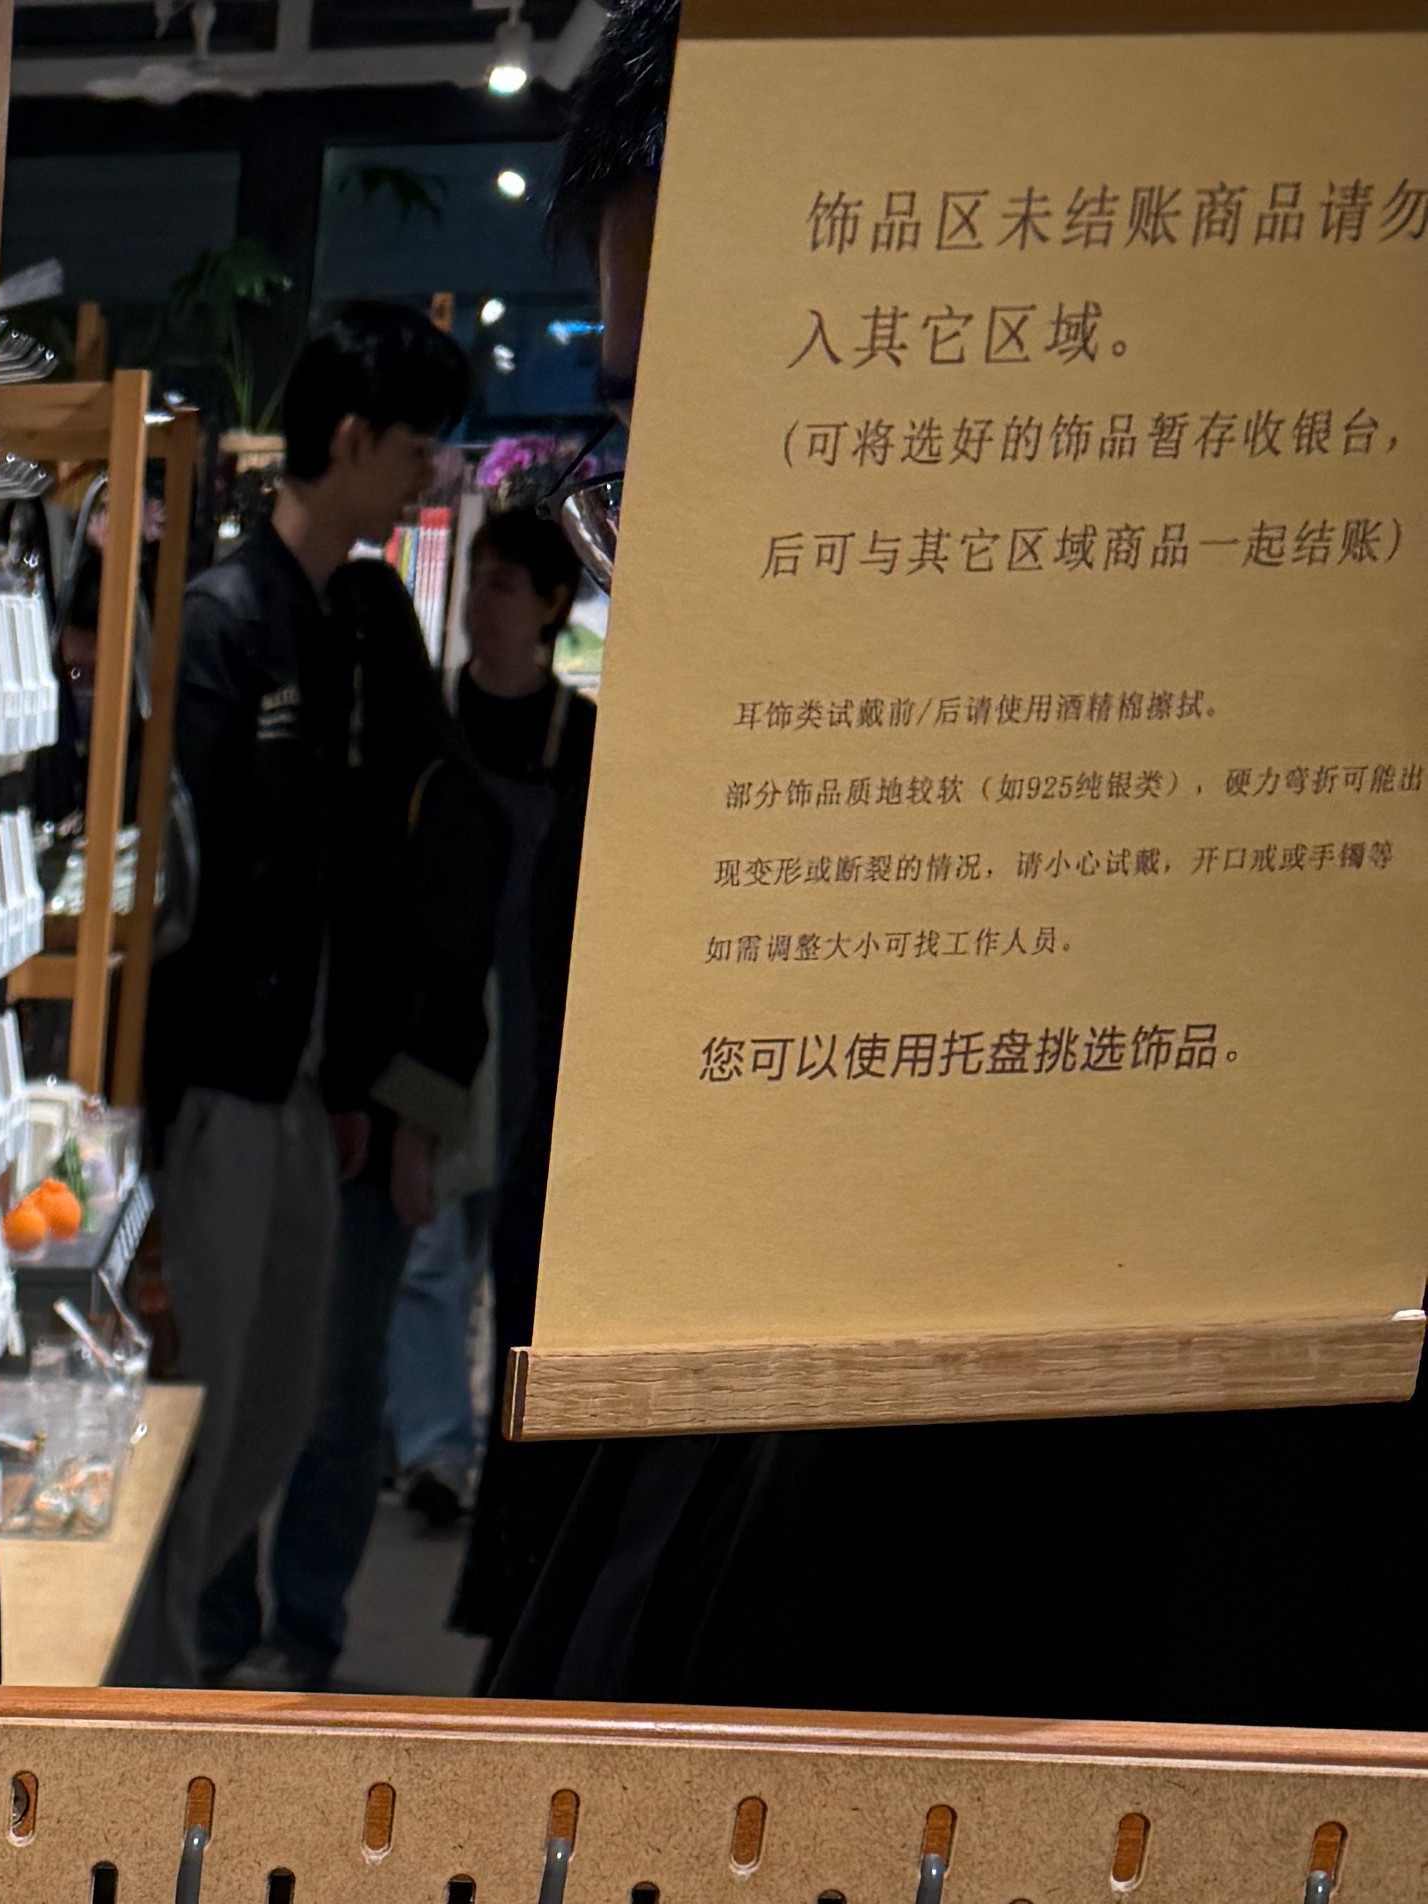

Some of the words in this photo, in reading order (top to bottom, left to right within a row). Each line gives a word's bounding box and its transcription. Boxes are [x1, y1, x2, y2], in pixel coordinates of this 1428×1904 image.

[805, 178, 1428, 256] 饰品区未结账商品请勿
[787, 302, 1131, 371] 入其它区域。
[733, 690, 1218, 731] 耳饰类试戴前/后请使用酒精棉擦拭。
[706, 927, 1075, 966] 如需调整大小可找工作人员。
[698, 1022, 1241, 1088] 您可以使用托盘挑选饰品。
